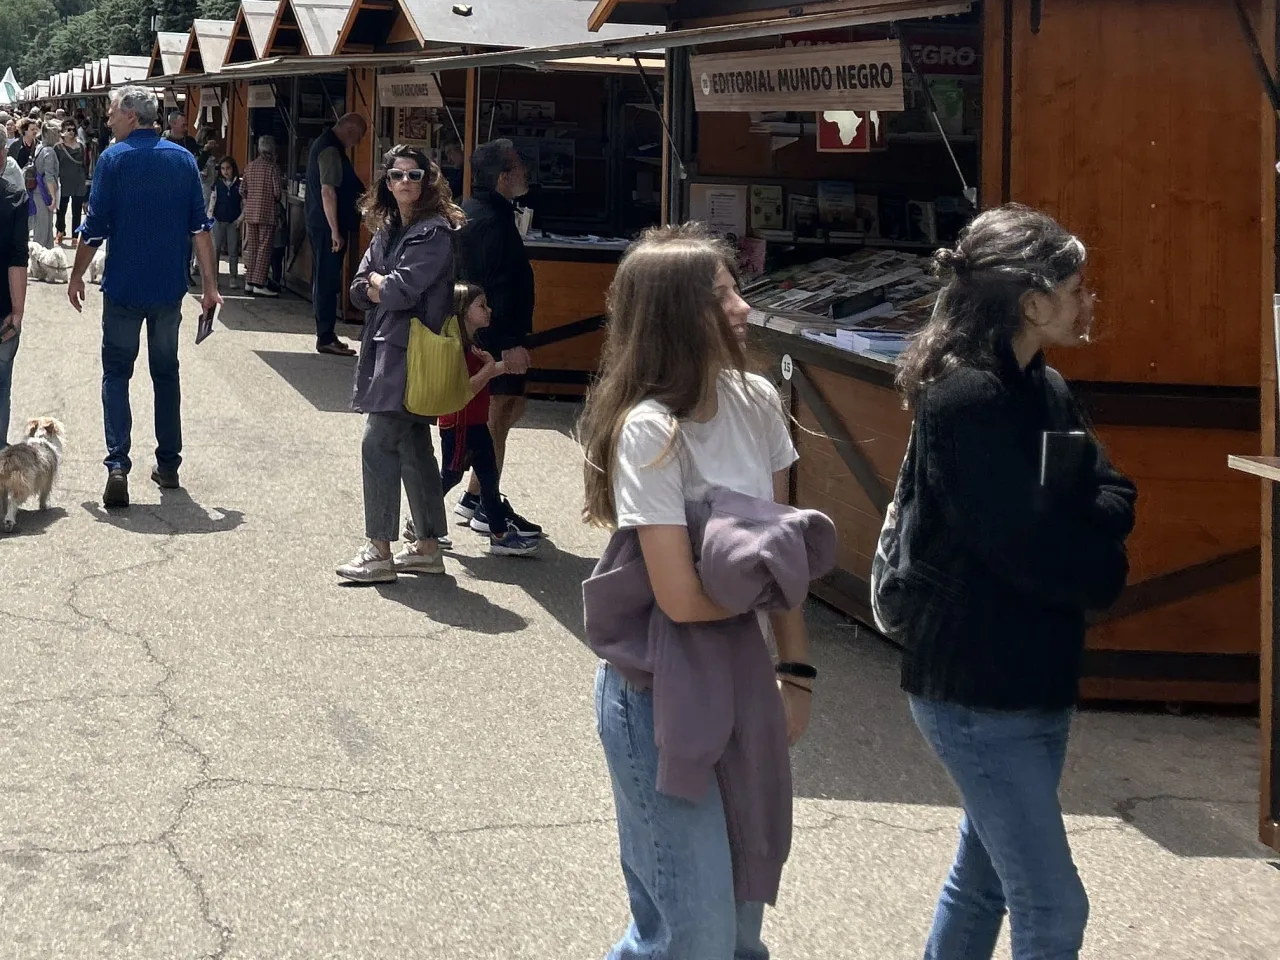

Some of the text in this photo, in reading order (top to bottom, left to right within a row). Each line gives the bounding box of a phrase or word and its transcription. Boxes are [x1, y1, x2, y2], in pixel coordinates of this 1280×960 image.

[902, 44, 977, 66] EGRO
[712, 69, 775, 94] EDITORIAL
[778, 66, 833, 92] MUNDO
[836, 62, 894, 90] NEGRO
[783, 361, 791, 373] 15
